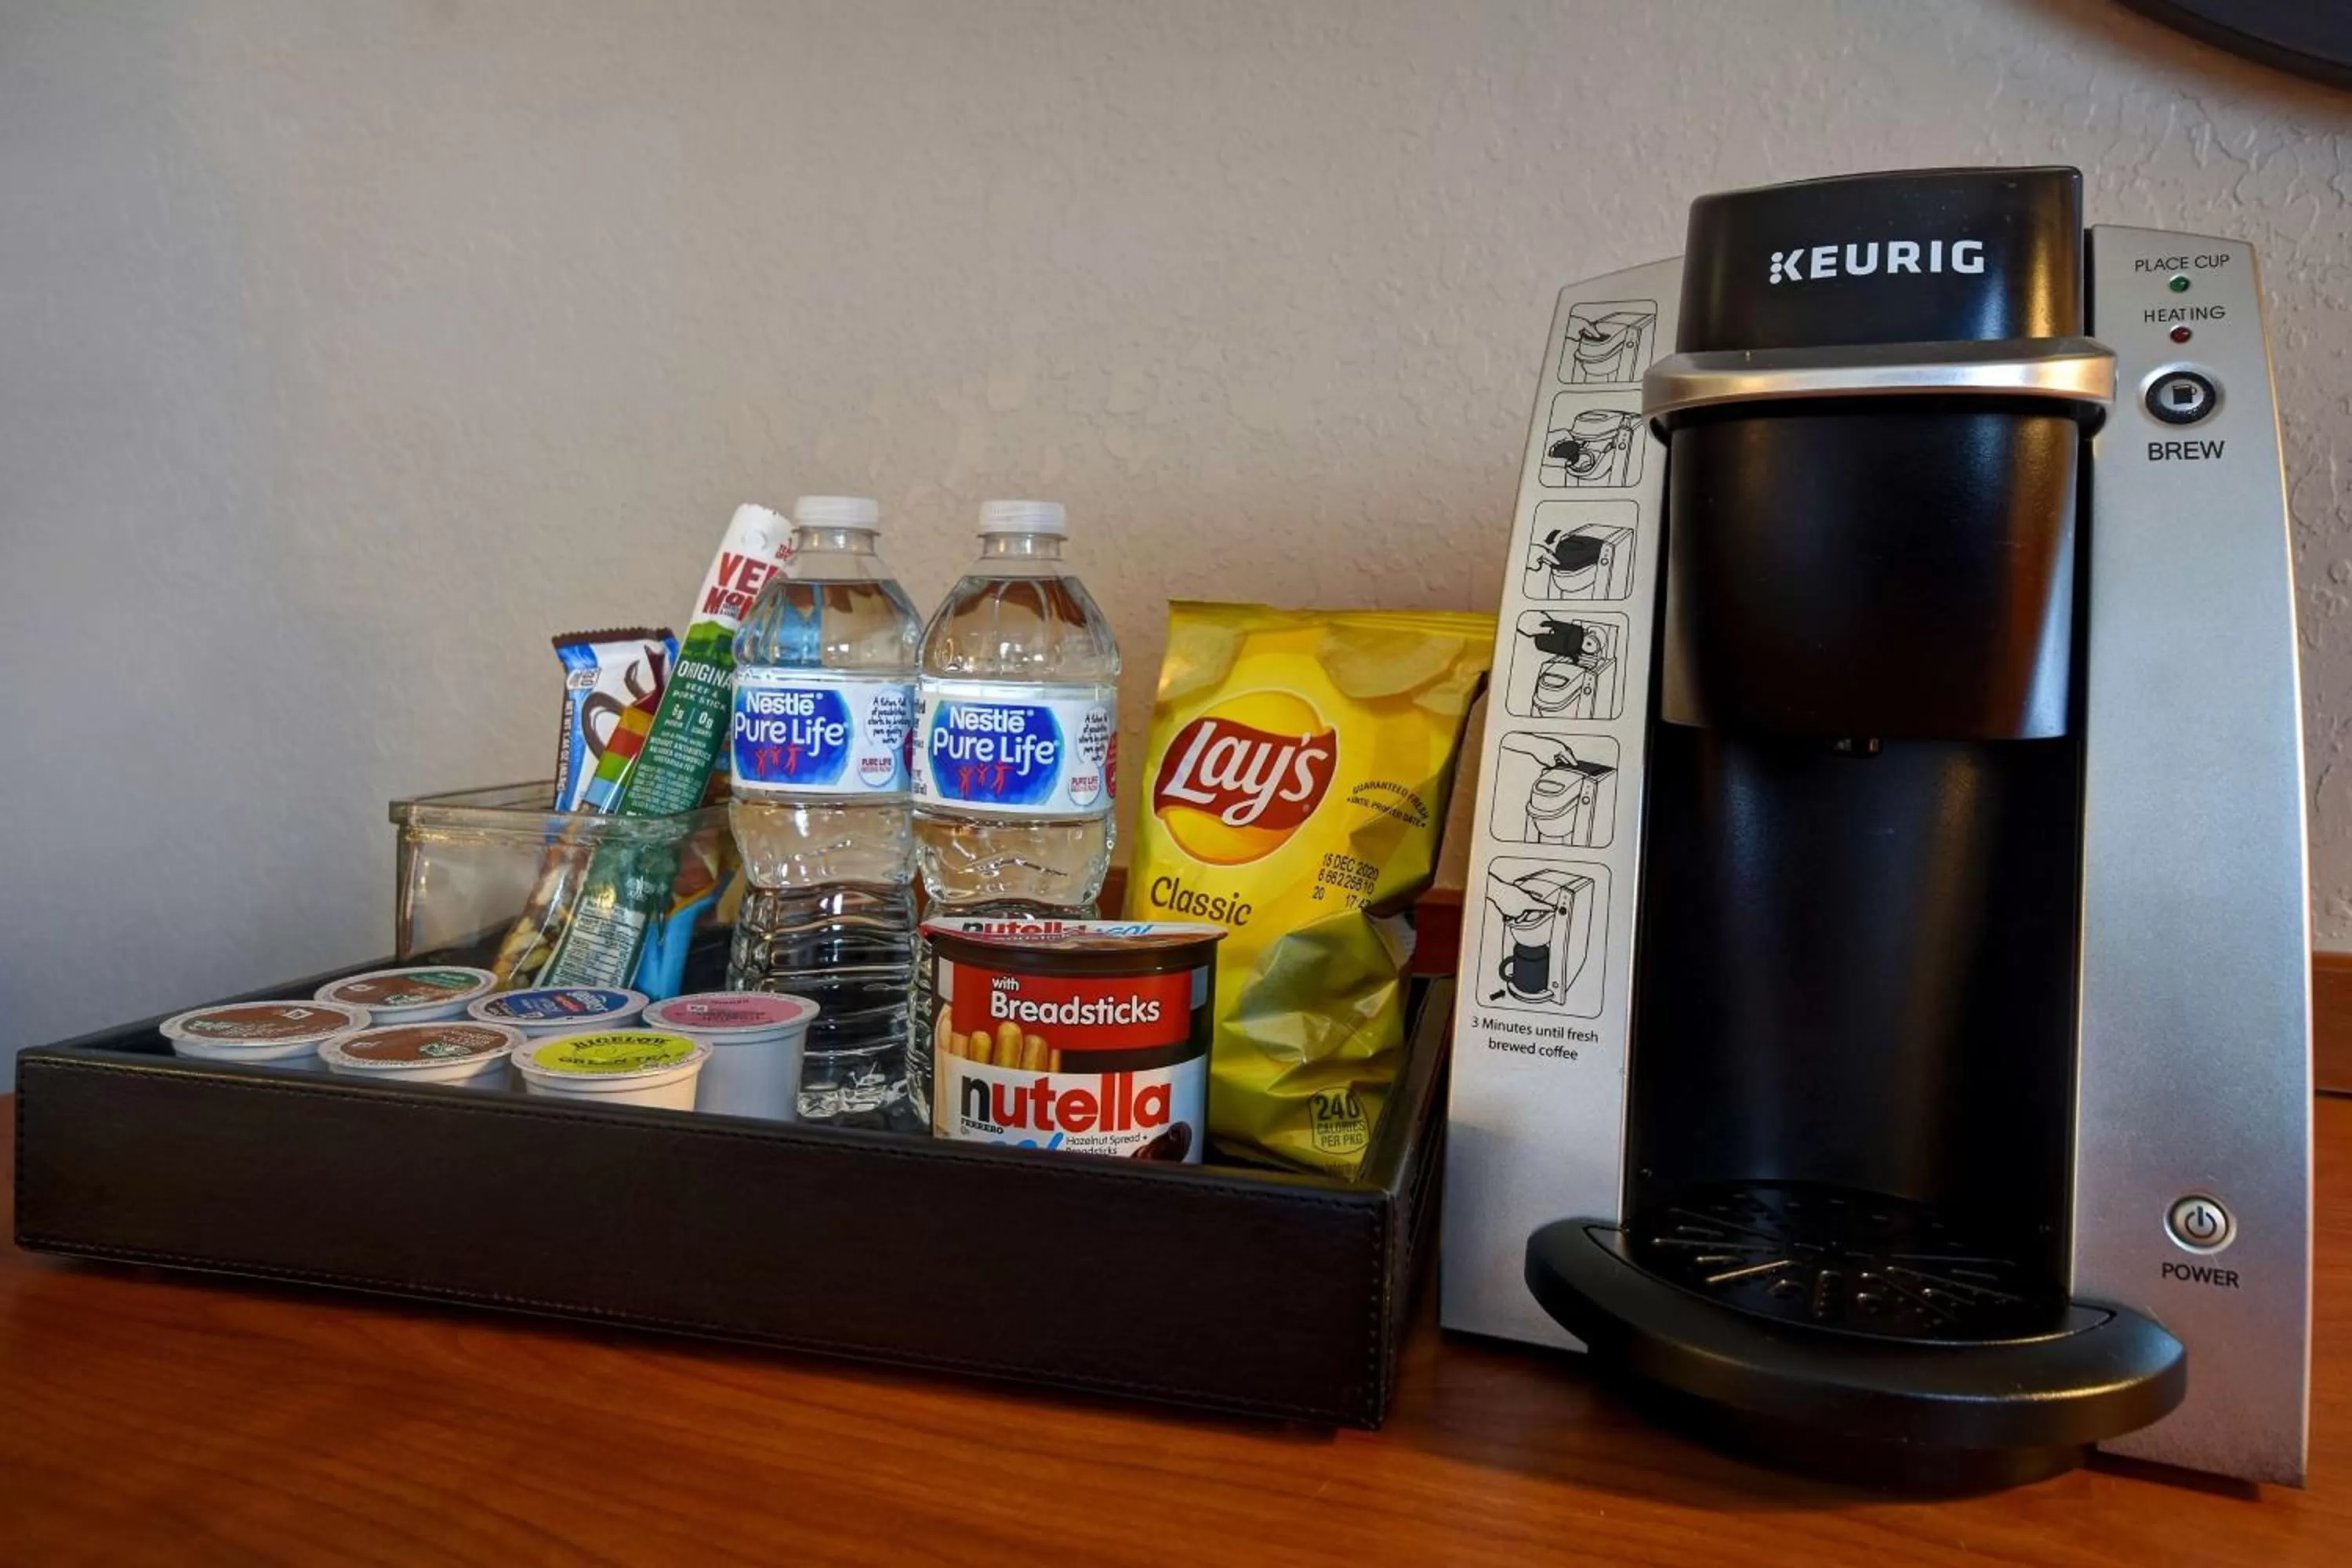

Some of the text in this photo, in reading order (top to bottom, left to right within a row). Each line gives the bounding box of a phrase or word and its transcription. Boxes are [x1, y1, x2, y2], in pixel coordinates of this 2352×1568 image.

[1769, 240, 1985, 285] KEURIG
[2134, 254, 2230, 272] PLACE CUP
[2144, 305, 2226, 323] HEATING
[2148, 441, 2225, 460] BREW
[746, 691, 815, 717] Nestlé
[949, 706, 1025, 733] Nestlé
[734, 713, 786, 744] Pure
[793, 717, 845, 756] Life
[934, 727, 1055, 776] Pure Life
[1161, 720, 1328, 826] Lay's
[1352, 781, 1428, 818] GUARANTEED FRESH
[1334, 855, 1355, 873] DEC
[1150, 876, 1252, 926] Classic
[962, 921, 1087, 936] nutella
[992, 977, 1019, 991] with
[990, 991, 1160, 1025] Breadsticks
[1472, 1016, 1599, 1043] 3 Minutes until fresh
[1489, 1036, 1578, 1061] brewed coffee
[961, 1072, 1171, 1133] nutella
[1316, 1089, 1360, 1121] 240
[961, 1117, 1004, 1134] FERRERO
[1317, 1119, 1366, 1134] CALORIES
[1065, 1135, 1108, 1146] Hazelnut
[1109, 1134, 1141, 1148] Spread
[1321, 1133, 1363, 1148] PER PKG
[2161, 1261, 2240, 1289] POWER
